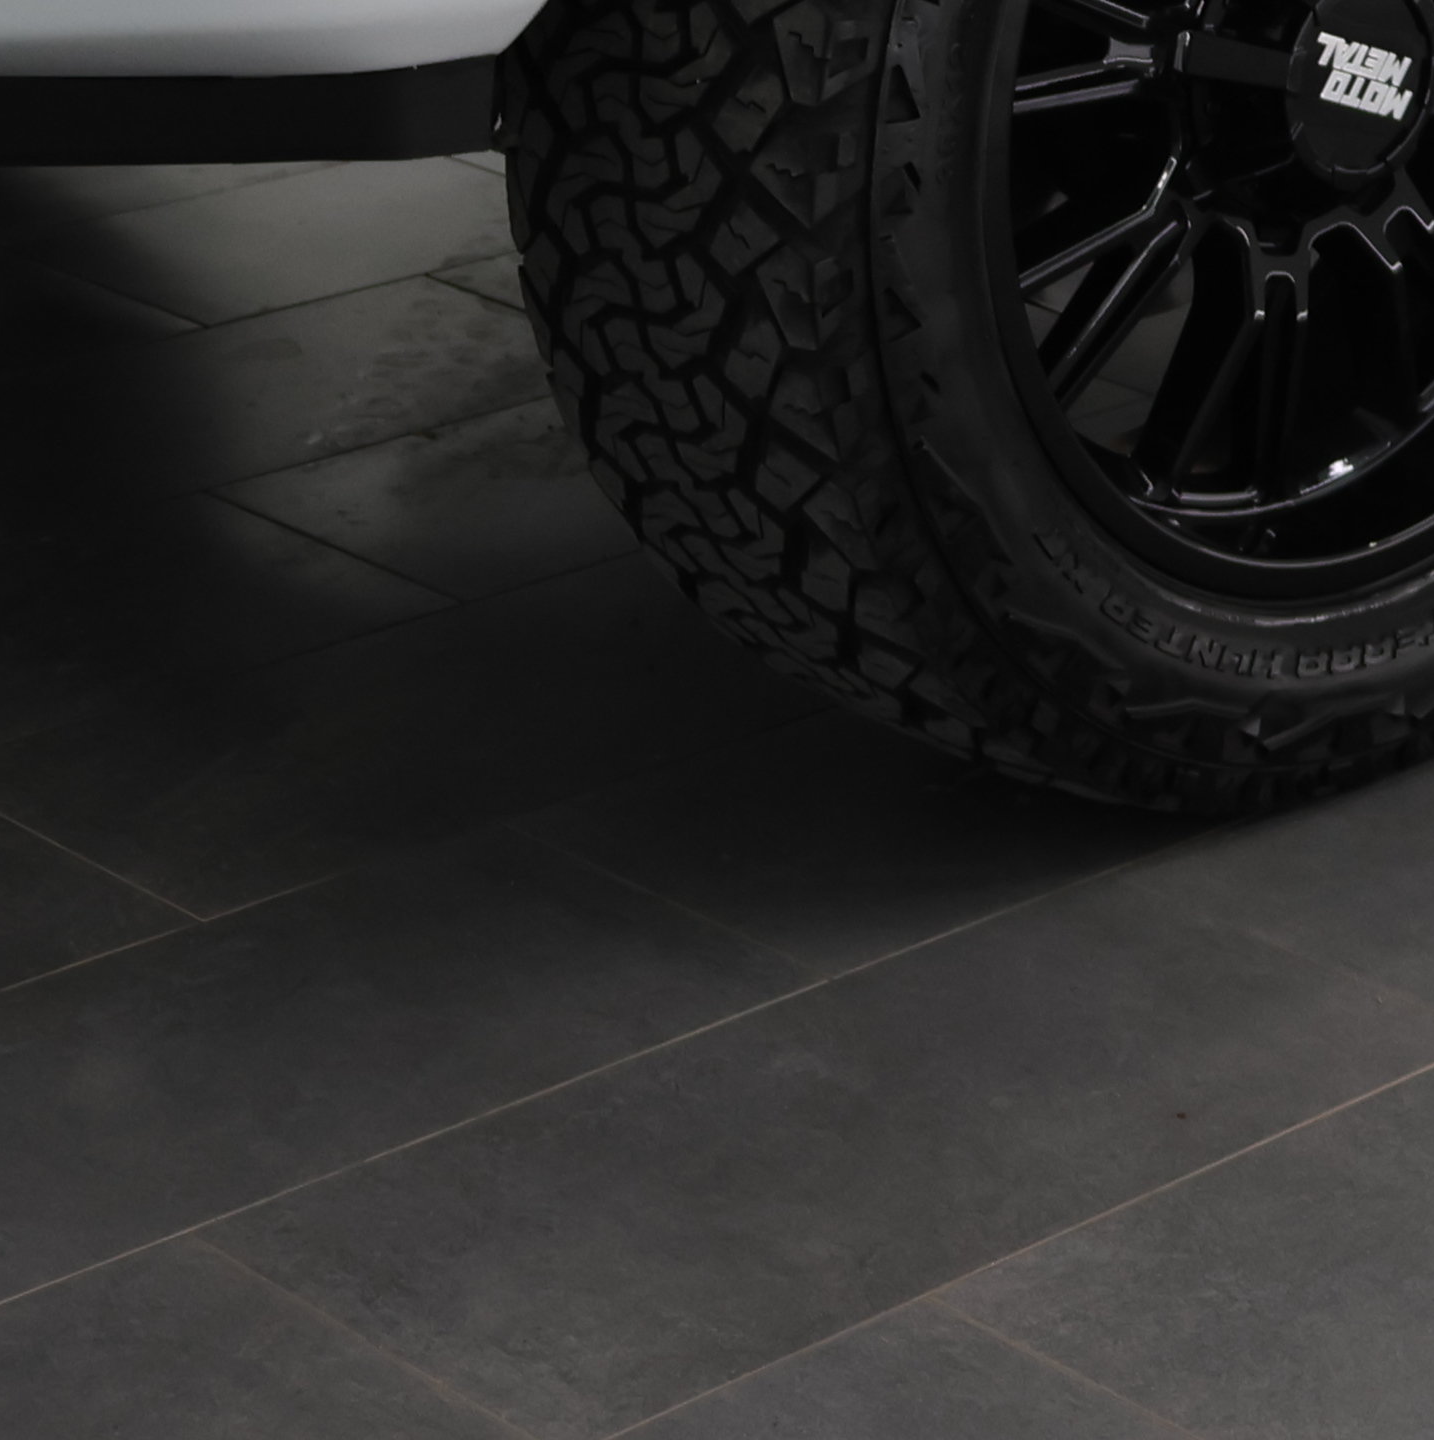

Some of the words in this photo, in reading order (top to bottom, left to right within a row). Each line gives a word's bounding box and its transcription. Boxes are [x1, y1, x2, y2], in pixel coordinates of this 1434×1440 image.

[1317, 31, 1412, 87] METAL
[1320, 69, 1413, 121] MOTO
[1099, 586, 1283, 680] HUNTER
